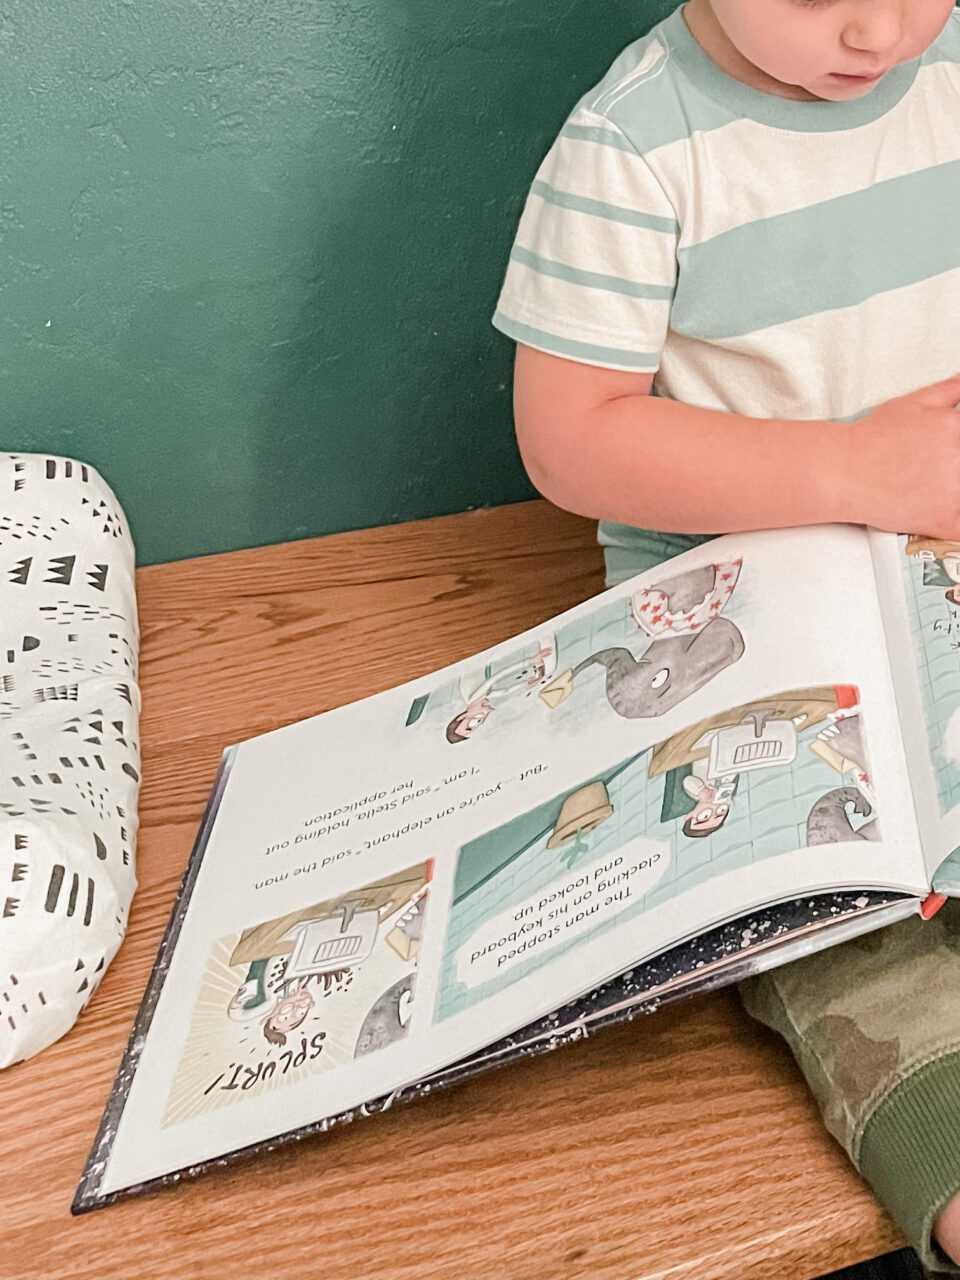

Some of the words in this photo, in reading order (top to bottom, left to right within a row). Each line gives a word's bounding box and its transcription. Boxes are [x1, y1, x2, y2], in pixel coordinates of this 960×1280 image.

[391, 780, 414, 794] her
[593, 856, 624, 880] and
[597, 853, 661, 892] clacking
[538, 875, 590, 911] looked
[572, 890, 593, 906] on
[604, 886, 633, 906] The
[547, 904, 569, 919] his
[565, 903, 600, 928] man
[470, 917, 543, 964] keyboard
[496, 925, 561, 967] stopped
[204, 1031, 327, 1096] SPLURT!
